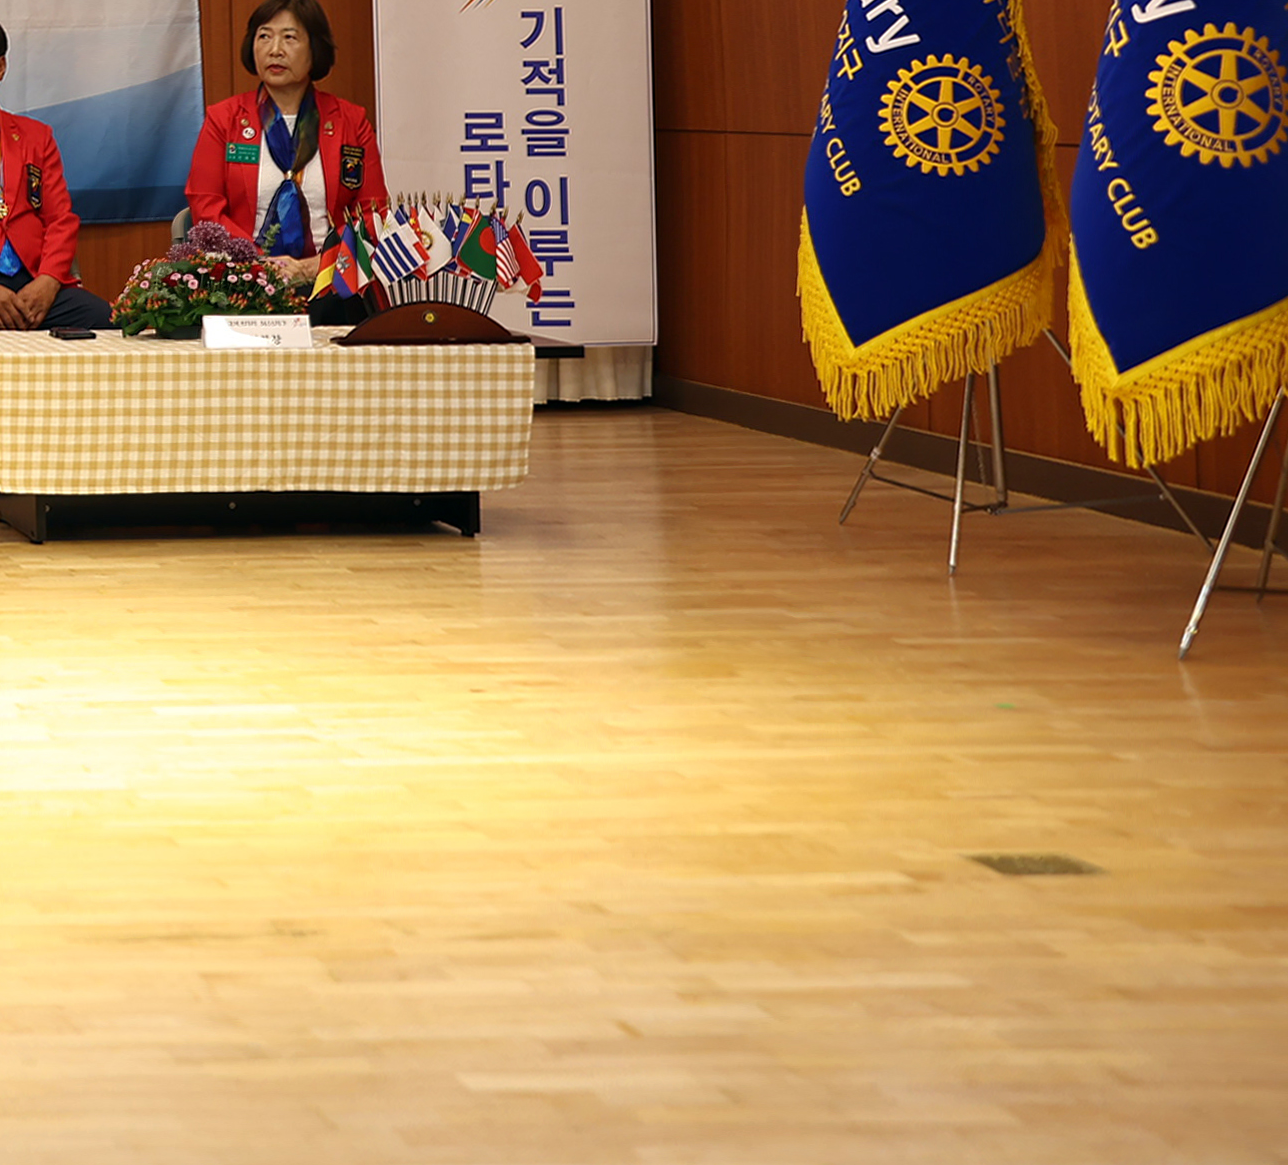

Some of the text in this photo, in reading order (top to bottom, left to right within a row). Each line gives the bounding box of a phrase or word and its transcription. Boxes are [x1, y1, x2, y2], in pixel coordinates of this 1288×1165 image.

[1162, 63, 1235, 153] INTERNATIONAL
[460, 111, 510, 211] 로타
[520, 6, 575, 328] 기적을 이루는
[826, 137, 862, 197] CLUB
[1107, 177, 1159, 250] CLUB
